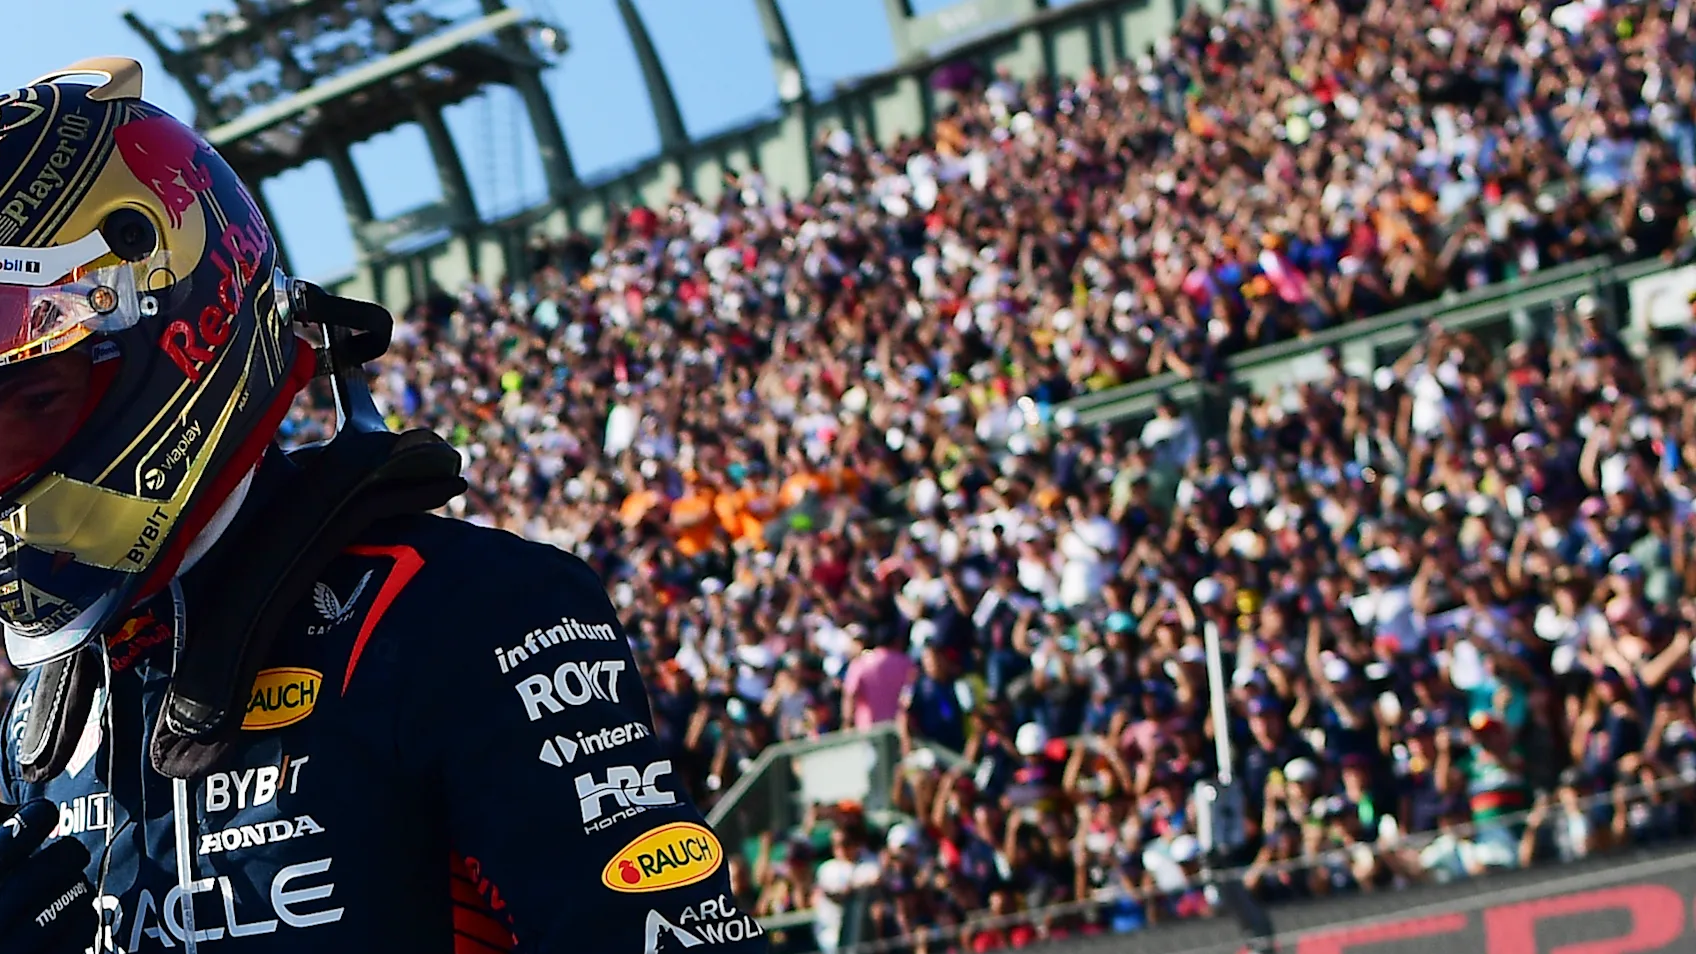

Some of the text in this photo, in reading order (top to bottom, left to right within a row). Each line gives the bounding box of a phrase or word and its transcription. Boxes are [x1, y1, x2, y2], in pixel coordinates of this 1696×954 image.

[161, 419, 202, 471] viaplay
[126, 506, 170, 565] BYBIT
[495, 617, 617, 674] infinitum
[515, 660, 626, 722] ROKT
[206, 755, 310, 812] BYBIT
[574, 759, 677, 824] HRC
[50, 796, 86, 840] bil
[199, 814, 326, 855] HONDA
[637, 836, 714, 878] RAUCH
[680, 894, 737, 926] ARC
